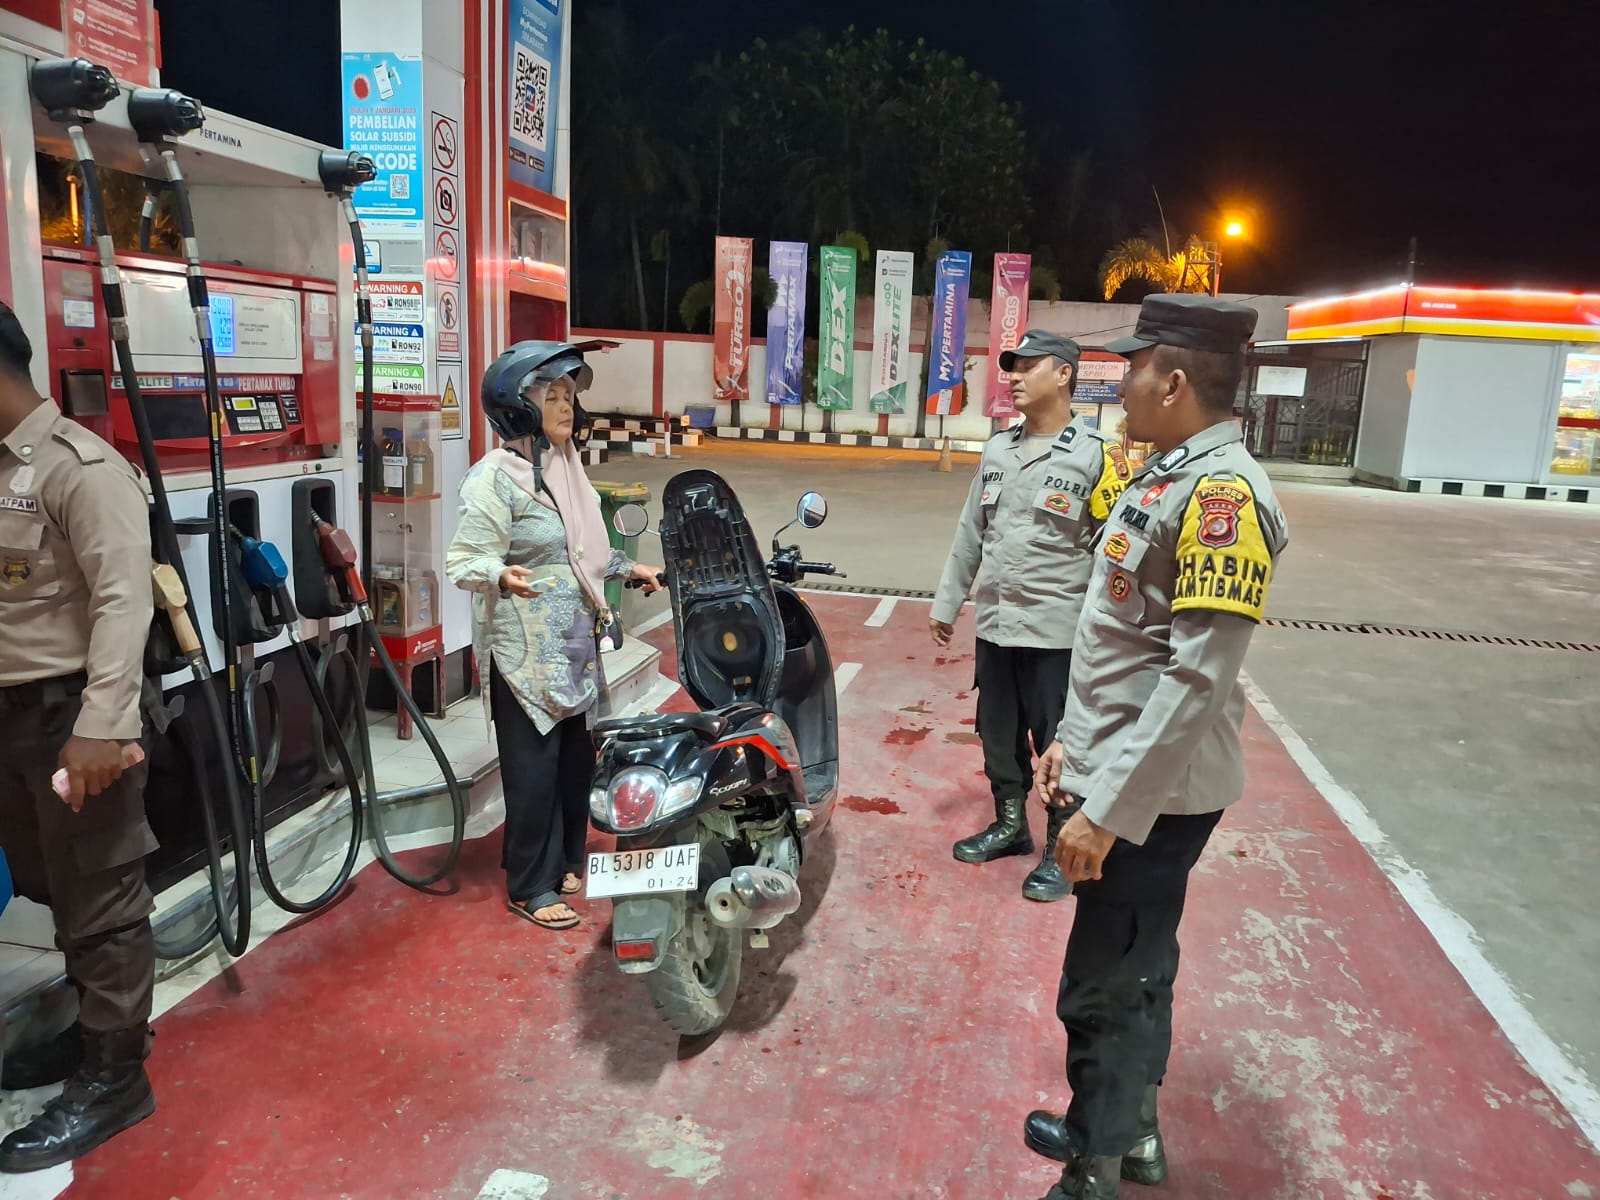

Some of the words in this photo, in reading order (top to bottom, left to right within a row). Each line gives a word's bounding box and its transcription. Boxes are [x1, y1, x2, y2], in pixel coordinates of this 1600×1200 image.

[350, 115, 417, 129] PEMBELIAN
[200, 127, 242, 148] PERTAMINA
[350, 131, 379, 142] SOLAR
[382, 131, 416, 142] SUBSIDI
[785, 275, 797, 371] PERTAMAX
[831, 281, 847, 377] DEX
[890, 284, 902, 382] DEXLITE
[998, 295, 1020, 384] BhtGas
[398, 341, 422, 351] RON92
[373, 368, 410, 377] ARNING
[239, 375, 272, 391] PERTAMAX
[274, 375, 295, 391] TURBO
[399, 382, 422, 391] RON90
[302, 464, 308, 474] 6
[1044, 475, 1088, 497] POLRI
[1201, 486, 1244, 501] POLRES
[1174, 576, 1263, 608] AMTIBMAS
[590, 856, 608, 875] BL
[613, 850, 655, 873] 5318
[664, 847, 696, 869] UAF
